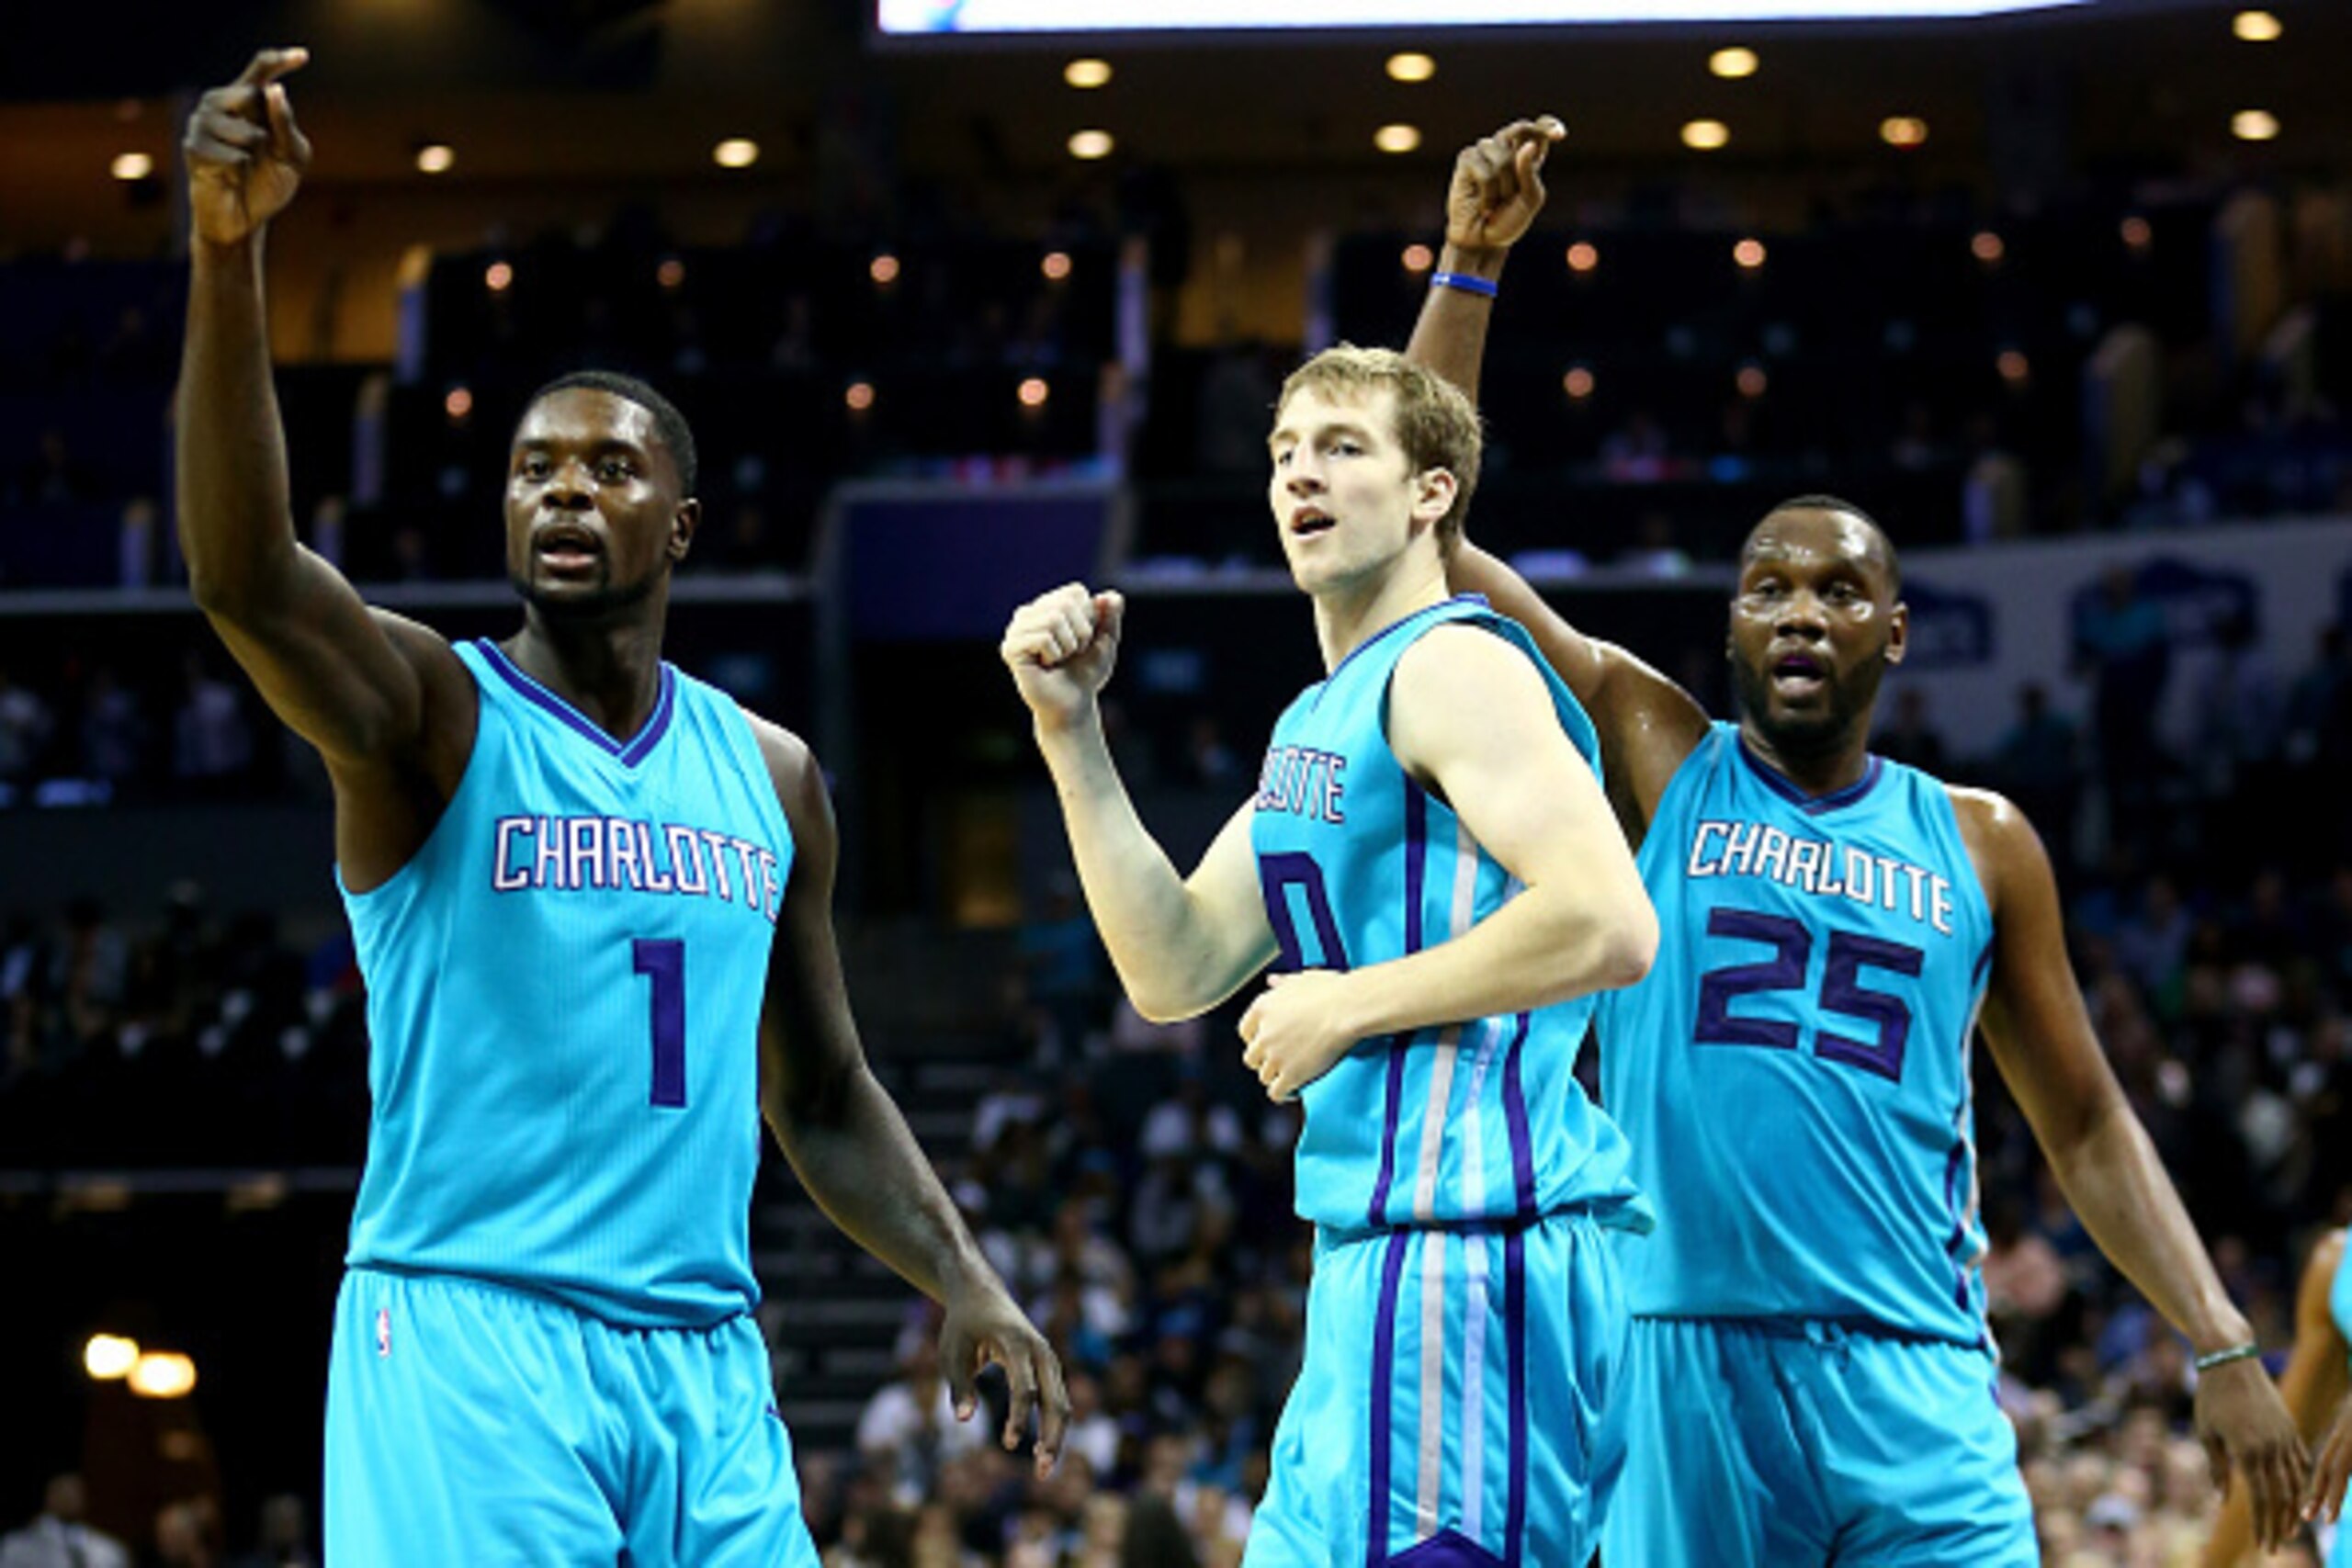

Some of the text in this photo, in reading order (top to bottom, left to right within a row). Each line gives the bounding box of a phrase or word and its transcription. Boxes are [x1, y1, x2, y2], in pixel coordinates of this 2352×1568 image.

[493, 815, 778, 926] CHARLOTTE
[1687, 820, 1953, 937] CHARLOTTE
[632, 938, 687, 1109] 1
[1693, 906, 1925, 1085] 25
